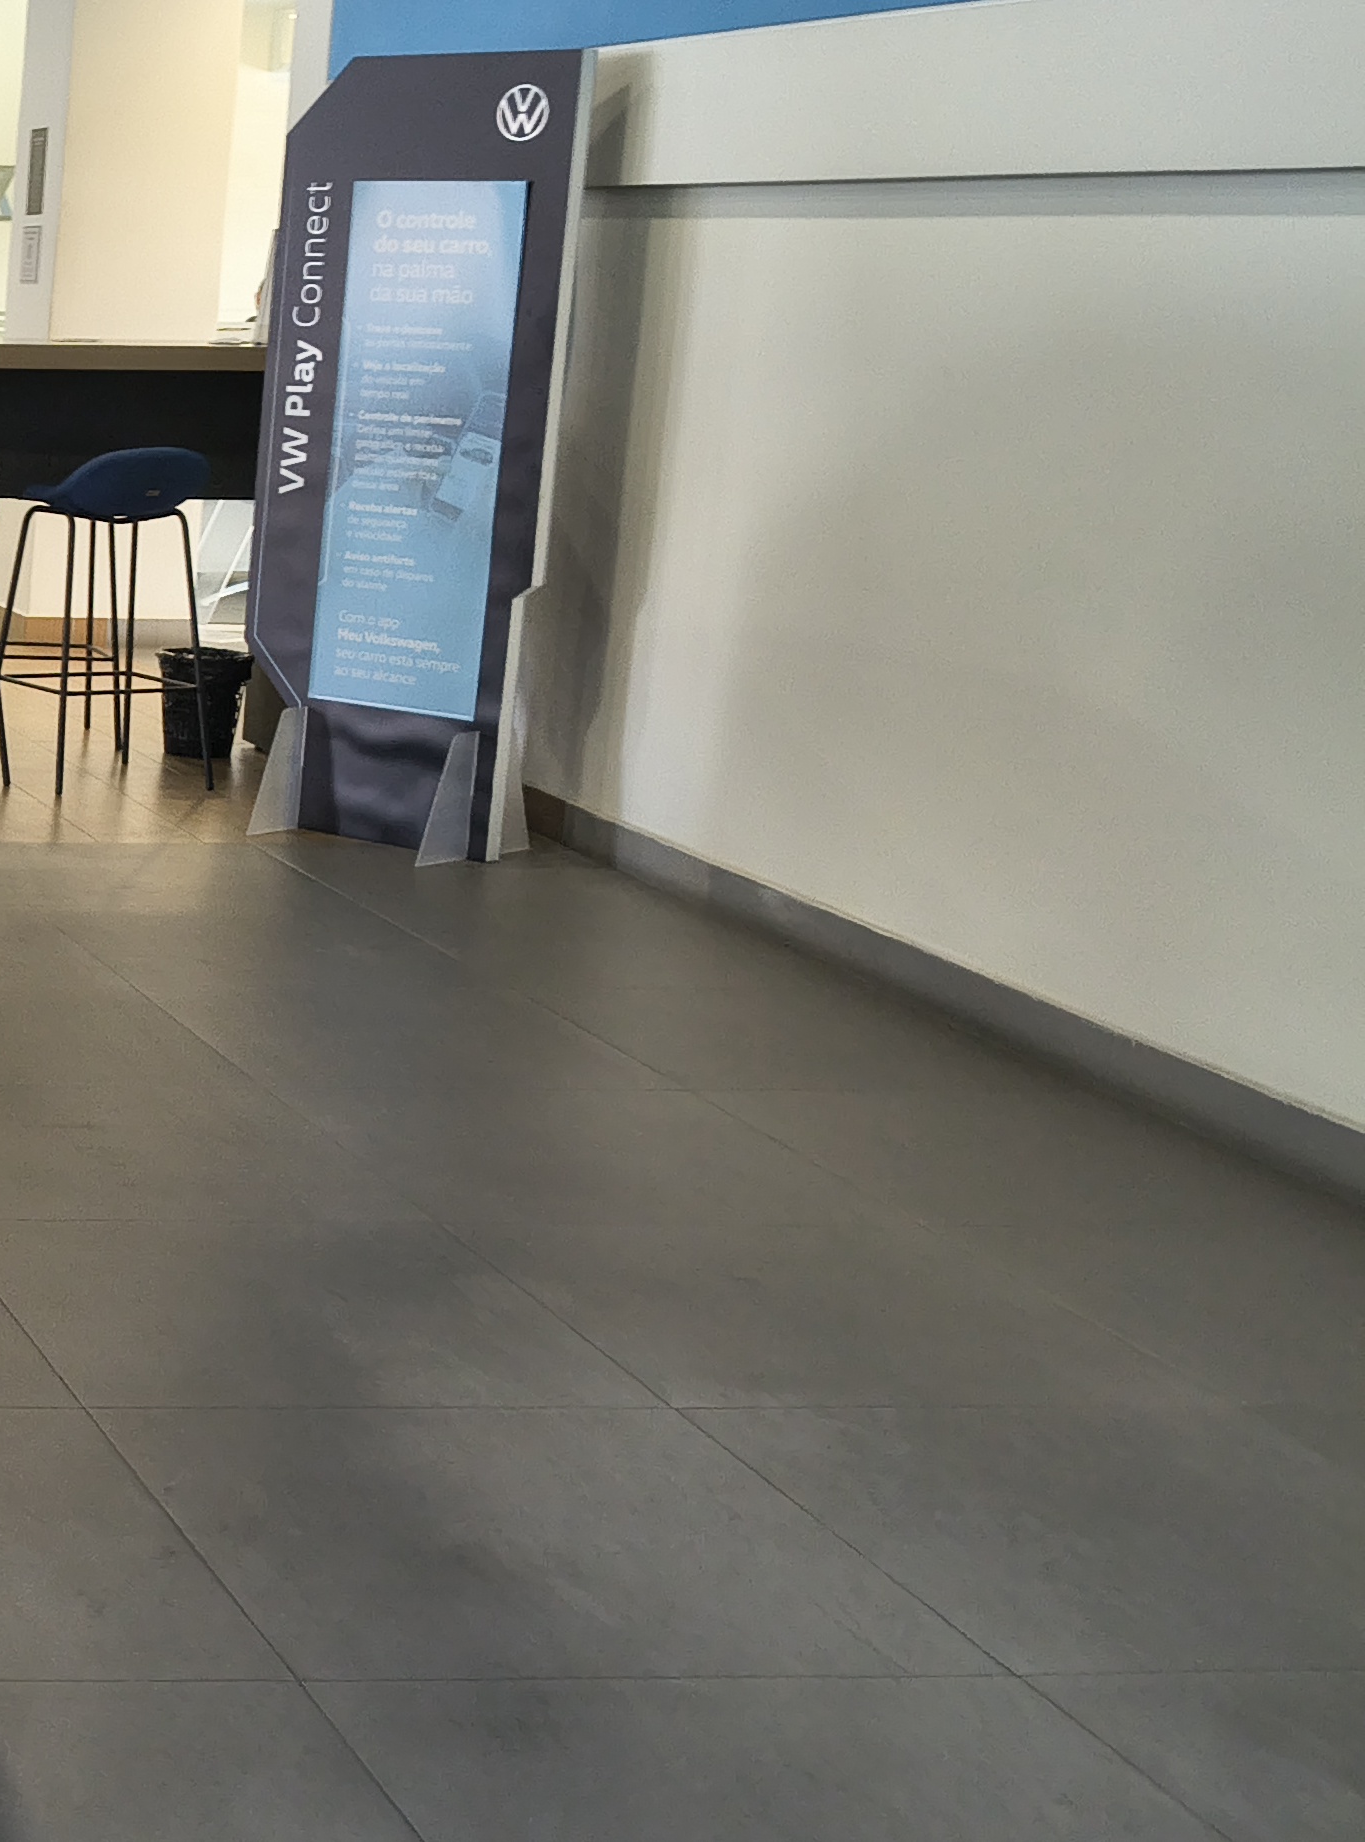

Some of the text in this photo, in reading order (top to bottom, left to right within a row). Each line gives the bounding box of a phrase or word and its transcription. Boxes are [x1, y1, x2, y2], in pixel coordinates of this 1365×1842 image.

[376, 210, 477, 229] O controle
[373, 235, 399, 253] do
[402, 239, 435, 253] seu
[372, 259, 455, 283] na palma
[369, 284, 392, 302] da
[396, 287, 427, 303] sua
[278, 182, 333, 494] VW Play Connect
[339, 609, 366, 624] Com
[337, 628, 363, 643] Meu
[335, 648, 356, 660] seu
[357, 650, 387, 663] carro
[416, 657, 461, 674] sempre
